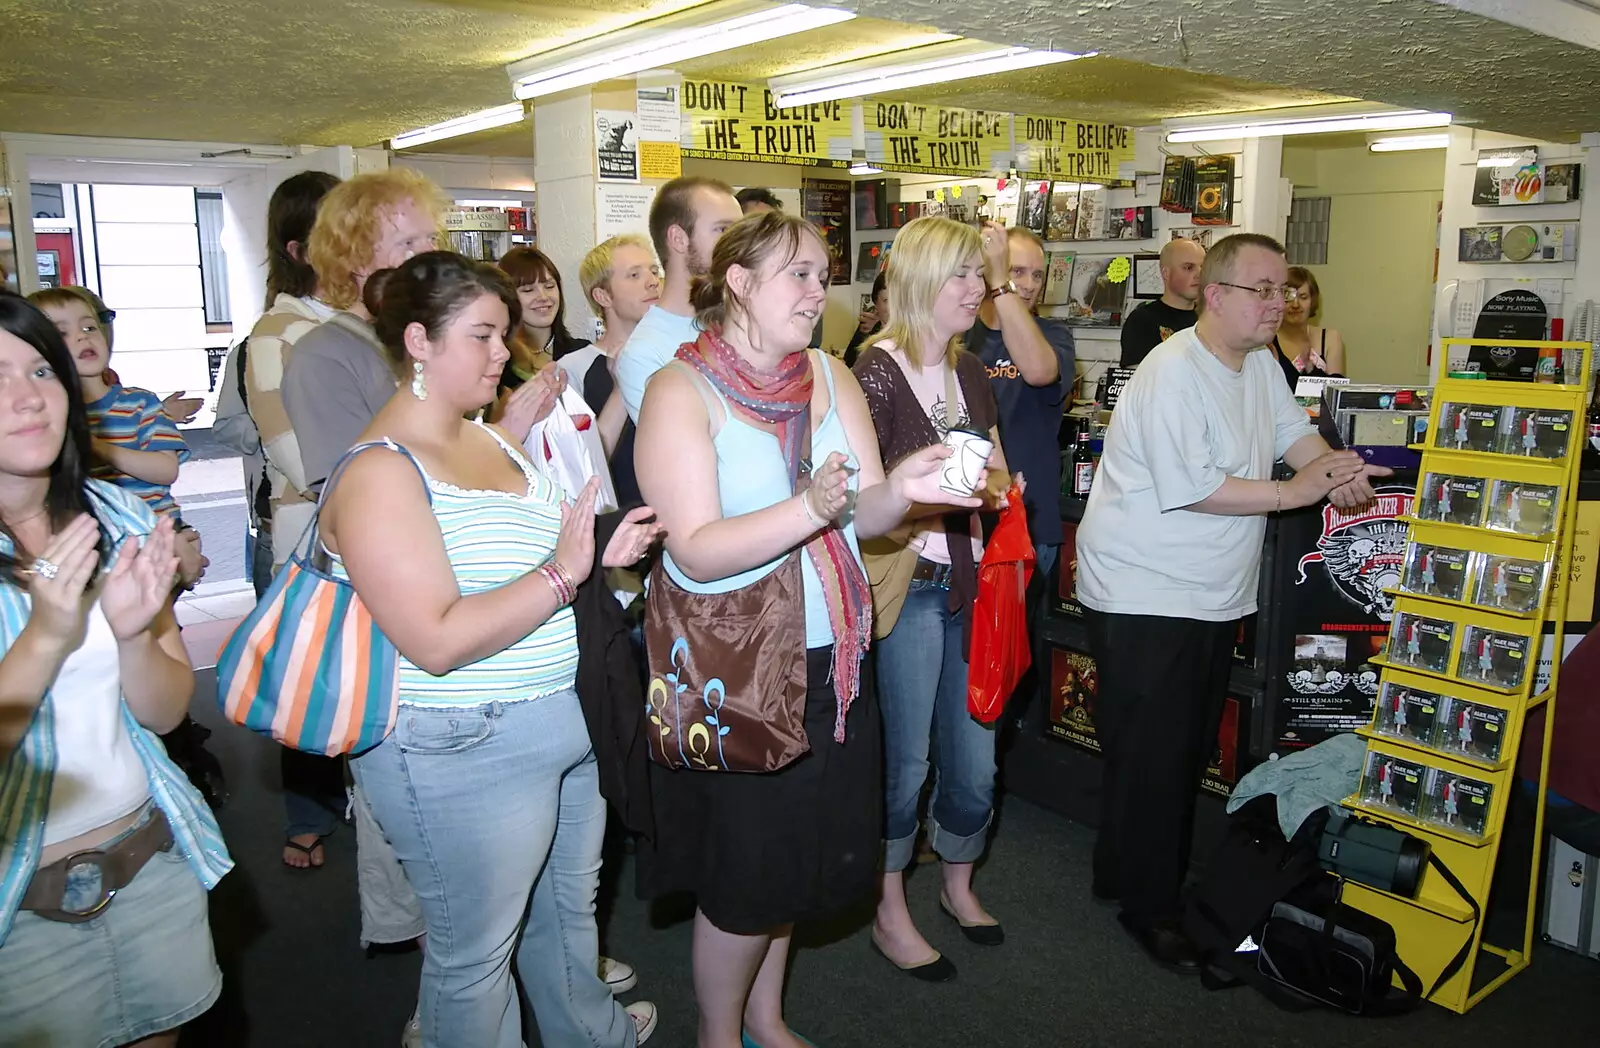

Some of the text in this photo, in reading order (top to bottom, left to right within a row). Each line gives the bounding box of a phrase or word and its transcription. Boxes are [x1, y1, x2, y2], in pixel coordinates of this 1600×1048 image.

[685, 82, 747, 112] DON'T
[877, 103, 1000, 139] DON'T BELIEVE
[1026, 118, 1128, 150] DON'T BELIEVE
[701, 120, 816, 154] THE TRUTH
[890, 137, 980, 167] THE TRUTH
[1038, 147, 1110, 176] THE TRUTH
